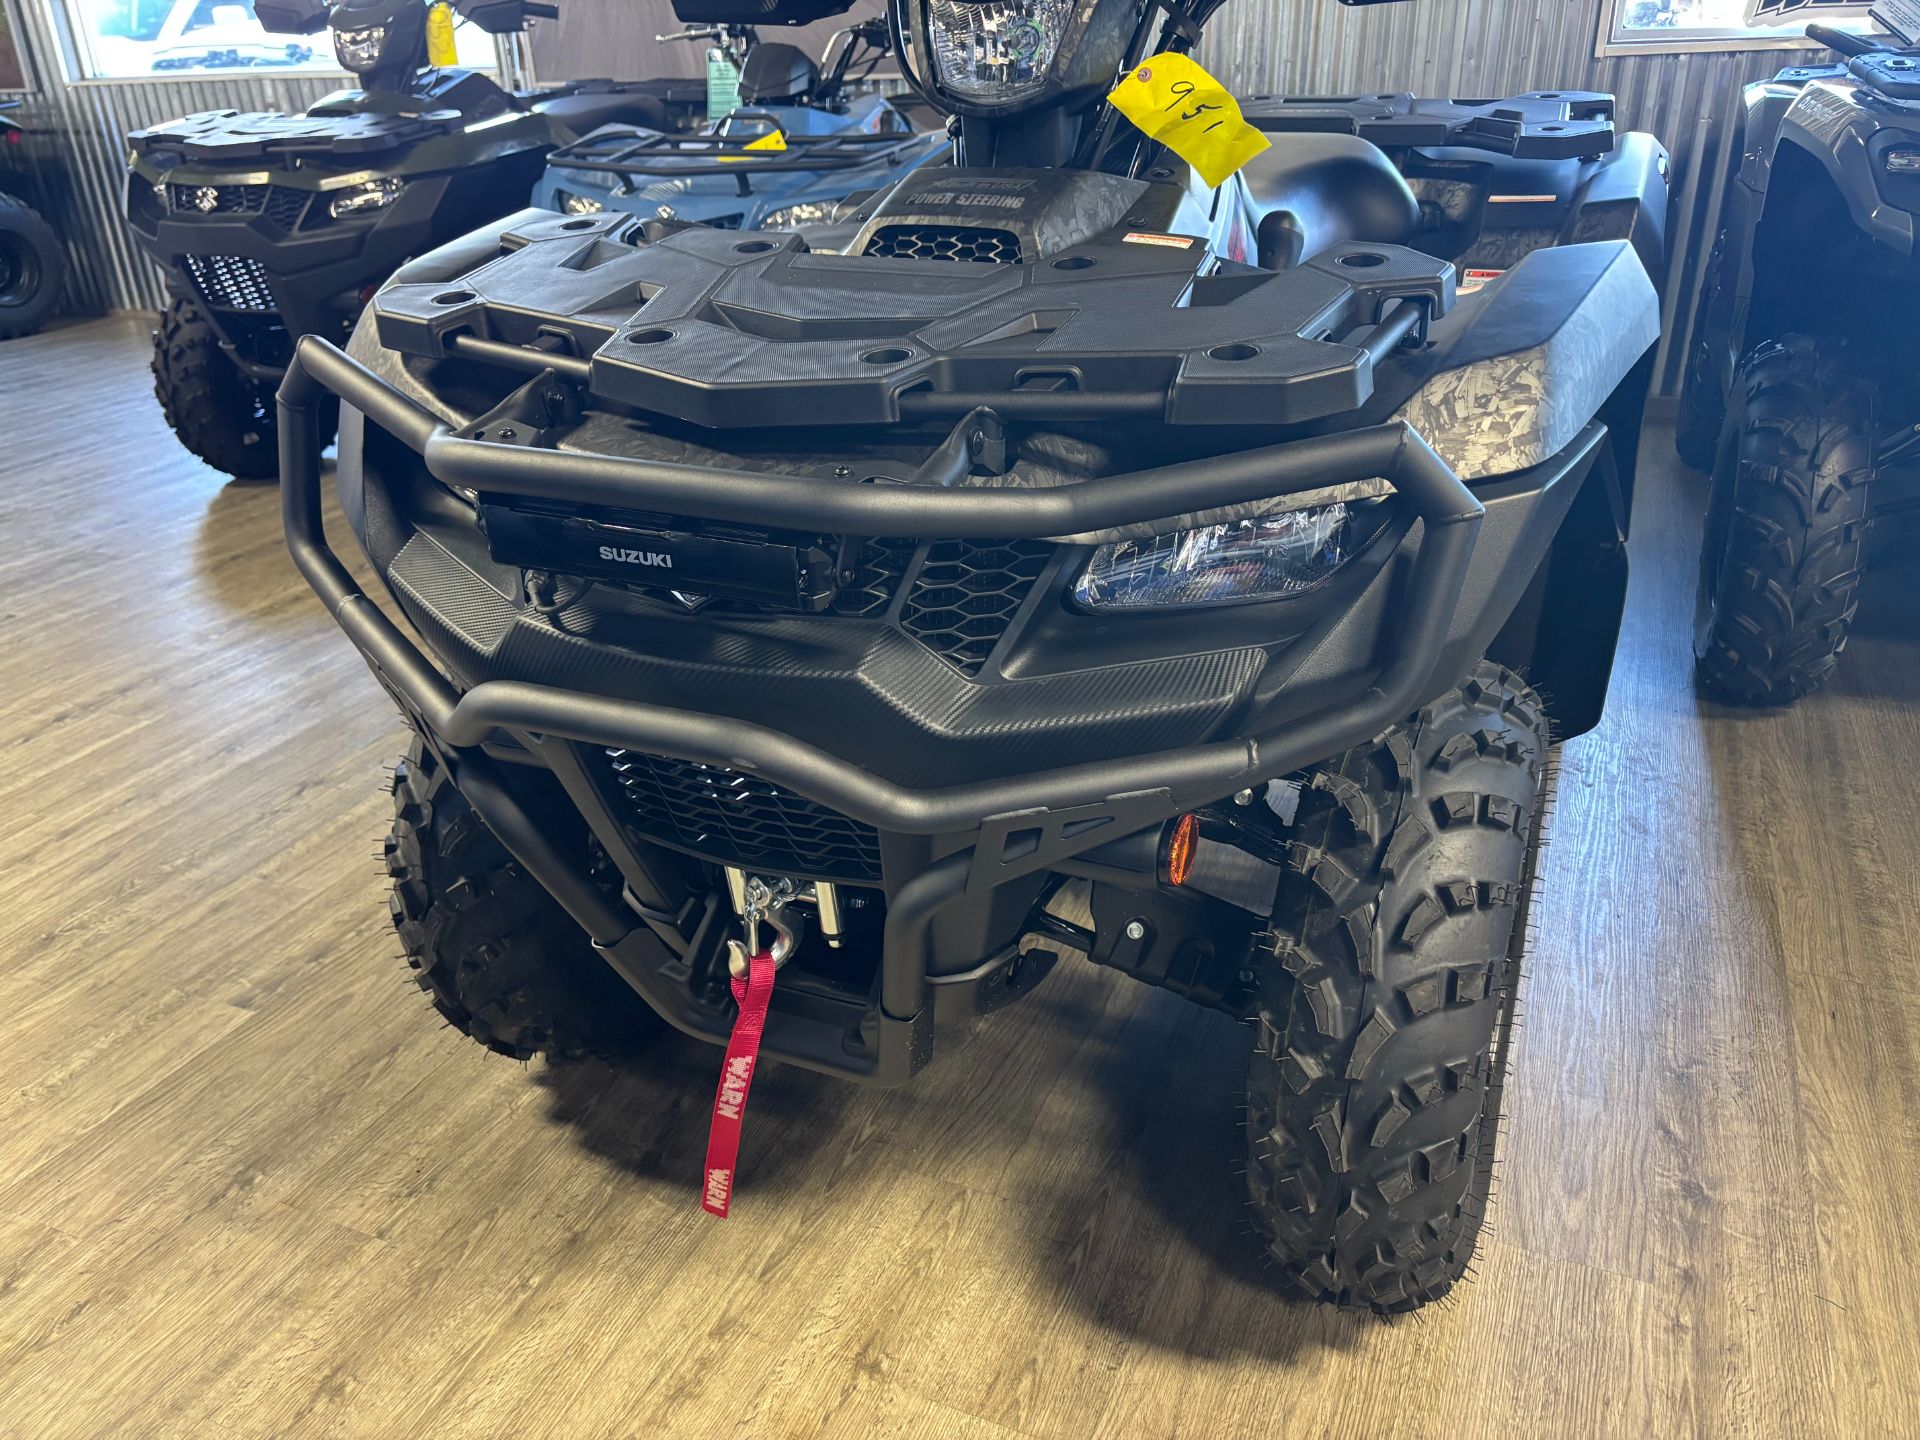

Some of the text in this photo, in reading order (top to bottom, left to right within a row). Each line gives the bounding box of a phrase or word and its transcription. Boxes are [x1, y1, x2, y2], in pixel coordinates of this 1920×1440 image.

[905, 192, 1026, 209] POWER STEERING
[599, 546, 673, 568] SUZUKI
[716, 1055, 753, 1120] WARN
[705, 1168, 731, 1210] WARN
